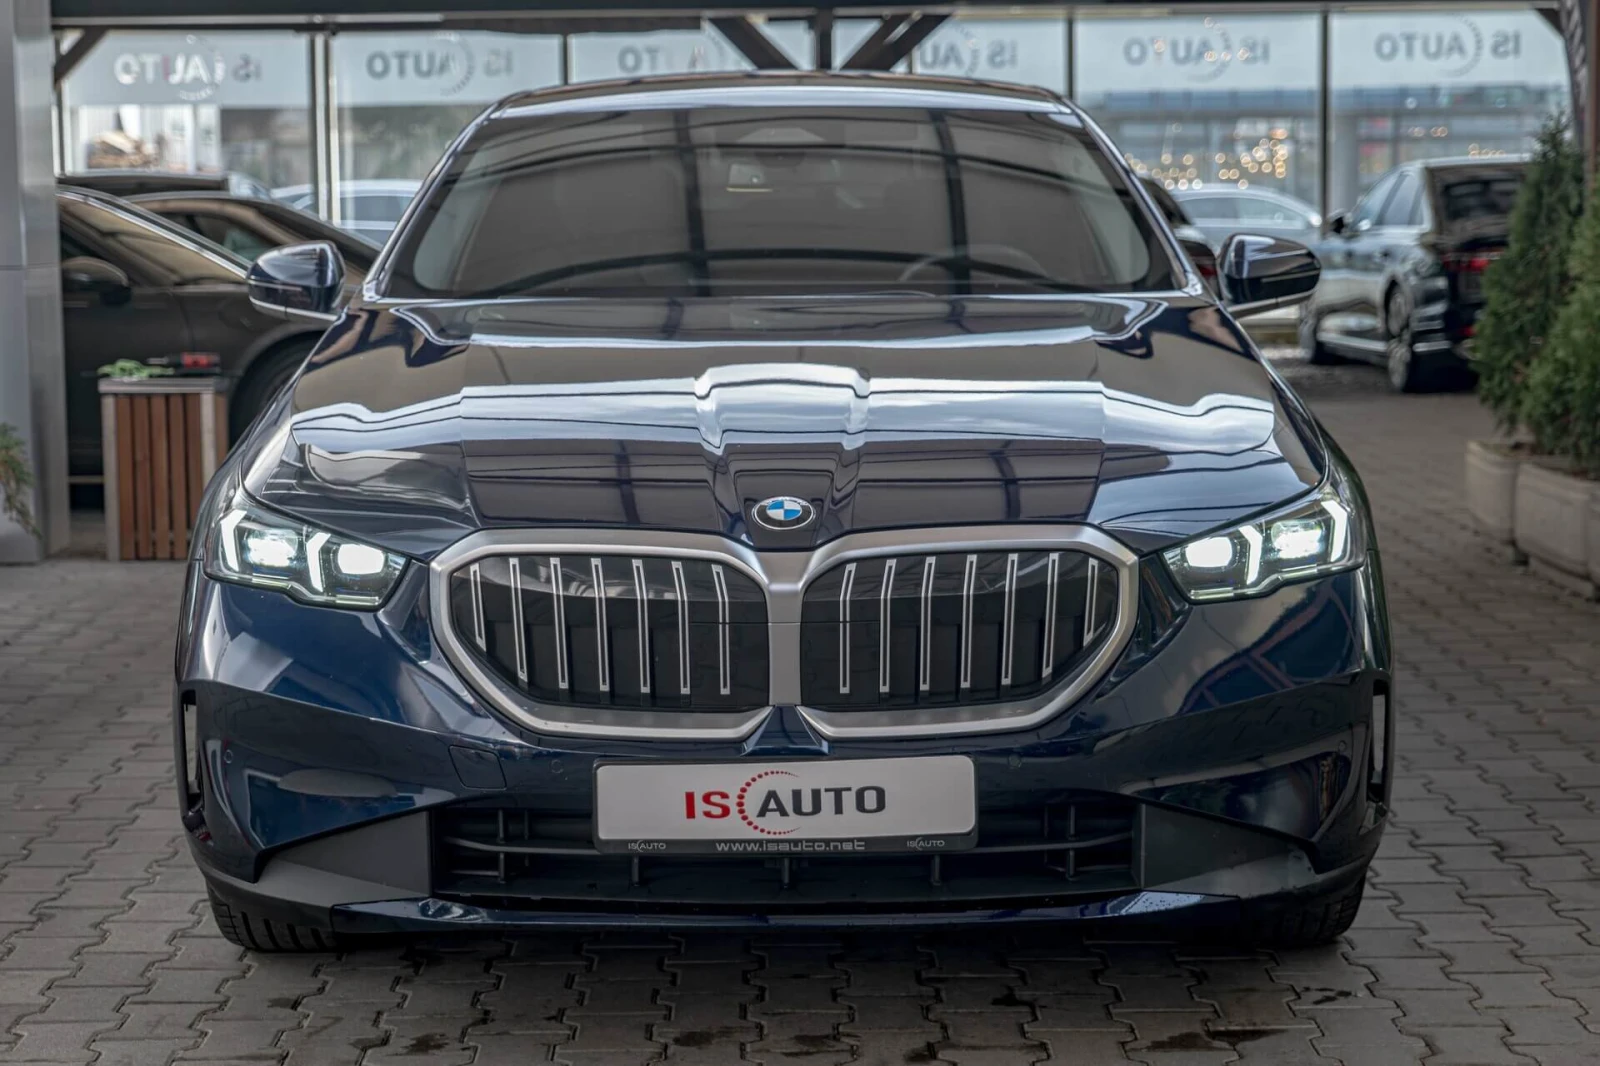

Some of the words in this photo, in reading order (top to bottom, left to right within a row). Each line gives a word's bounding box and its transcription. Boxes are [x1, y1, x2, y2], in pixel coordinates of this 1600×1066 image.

[685, 791, 731, 820] IS
[756, 786, 886, 818] AUTO
[715, 840, 866, 852] www.isauto.net
